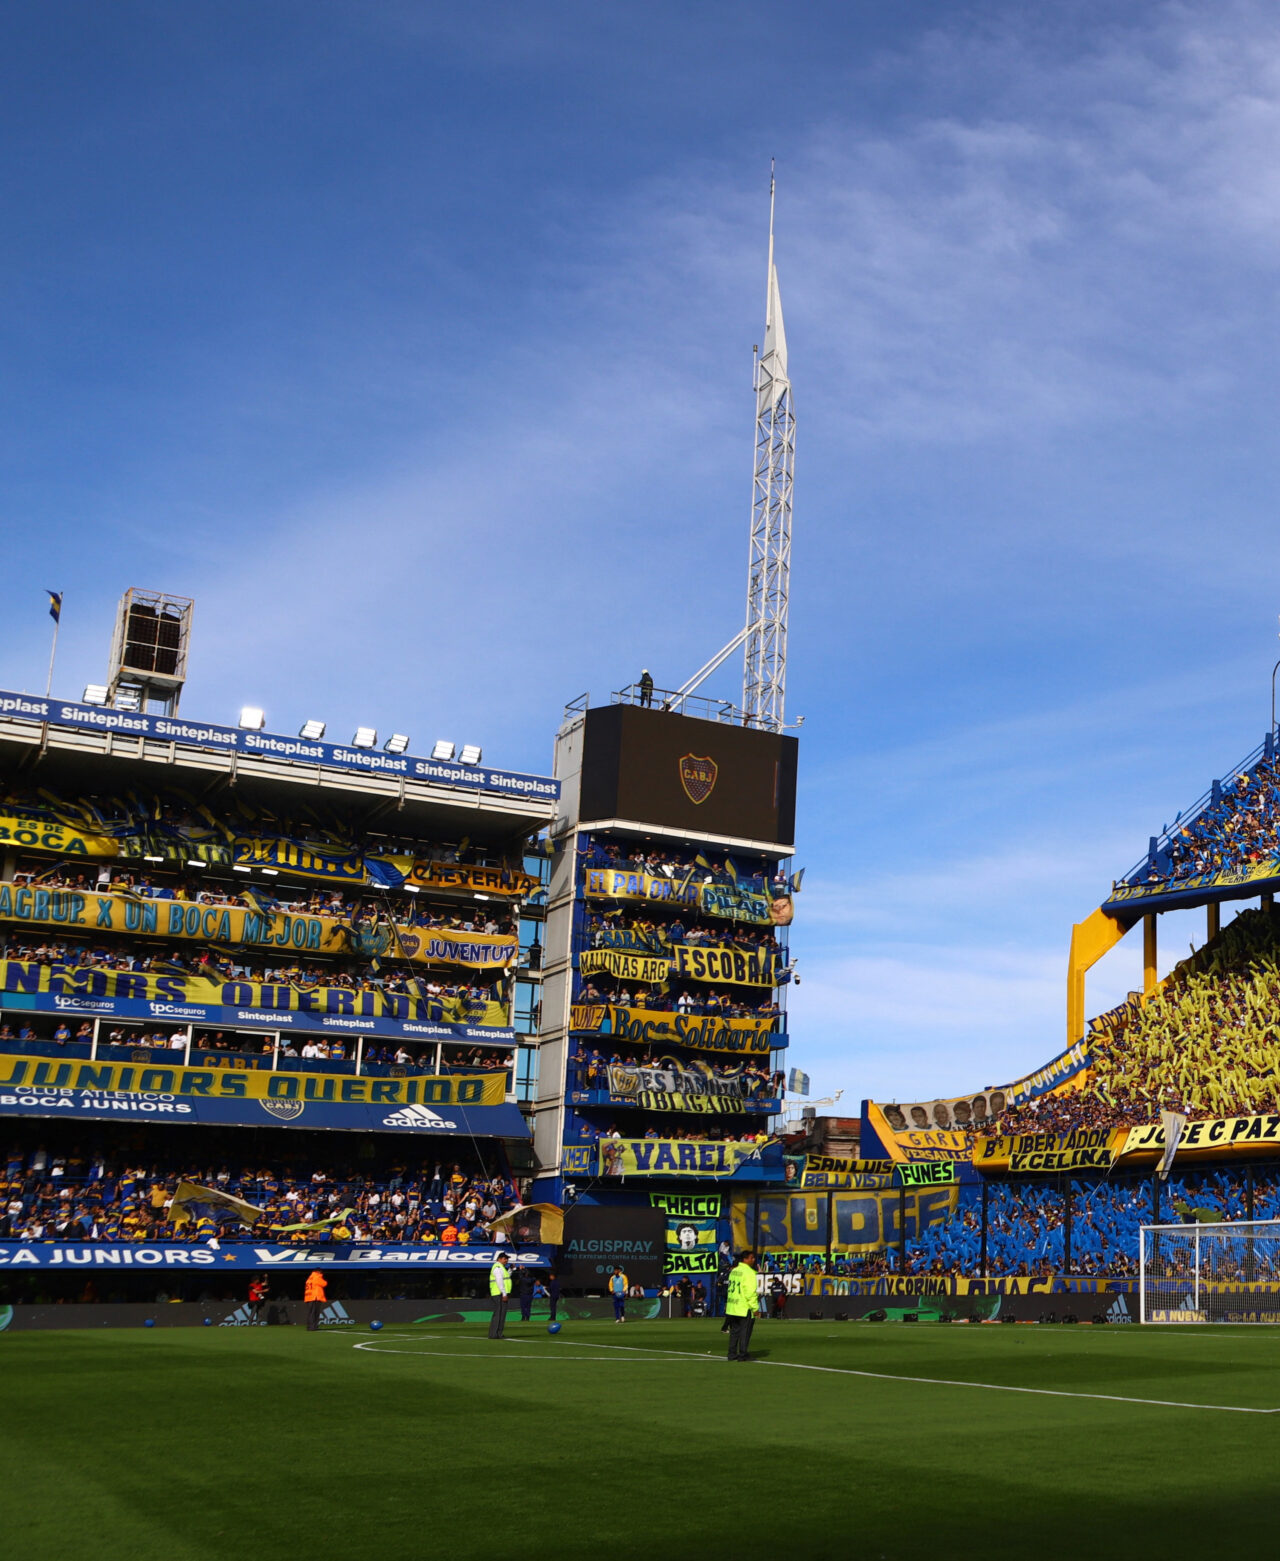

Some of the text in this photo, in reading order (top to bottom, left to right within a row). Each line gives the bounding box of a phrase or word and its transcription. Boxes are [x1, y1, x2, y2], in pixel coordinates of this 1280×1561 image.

[61, 706, 324, 759] Sinteplast Sinteplast Sinteplast
[332, 748, 557, 795] Sinteplast Sinteplast Sinteplast
[684, 768, 713, 783] CABJ
[18, 820, 65, 834] ES DE
[0, 826, 89, 855] BOCA
[590, 871, 607, 893] EL
[703, 888, 769, 919] PILAR
[97, 898, 113, 929] X
[125, 902, 157, 934] UN
[169, 903, 231, 941] BOCA
[242, 912, 322, 950] MEJOR
[237, 1010, 294, 1024] Sinteplast
[322, 1017, 376, 1030] Sinteplast
[402, 1023, 453, 1035] Sinteplast
[466, 1027, 515, 1040] Sinteplast
[613, 1007, 772, 1051] Boca Solidario
[1, 1061, 485, 1104] JUNIORS QUERIDO
[0, 1094, 192, 1114] BOCA JUNIORS
[15, 1086, 176, 1102] CLUB ATLETICO
[637, 1091, 746, 1114] OBLIGADO
[382, 1116, 457, 1130] adidas
[630, 1142, 732, 1172] VAREL
[806, 1155, 895, 1174] SAN LUIS
[804, 1173, 893, 1188] BELLA VISTA
[901, 1160, 953, 1184] FUNES
[653, 1195, 719, 1216] CHACO
[743, 1189, 952, 1250] BUDGE
[347, 1249, 541, 1263] Bariloche
[567, 1239, 654, 1253] ALGISPRAY
[49, 1249, 214, 1265] JUNIORS
[663, 1252, 718, 1273] SALTA
[317, 1317, 356, 1325] didas
[1152, 1309, 1207, 1322] LA NUEVA
